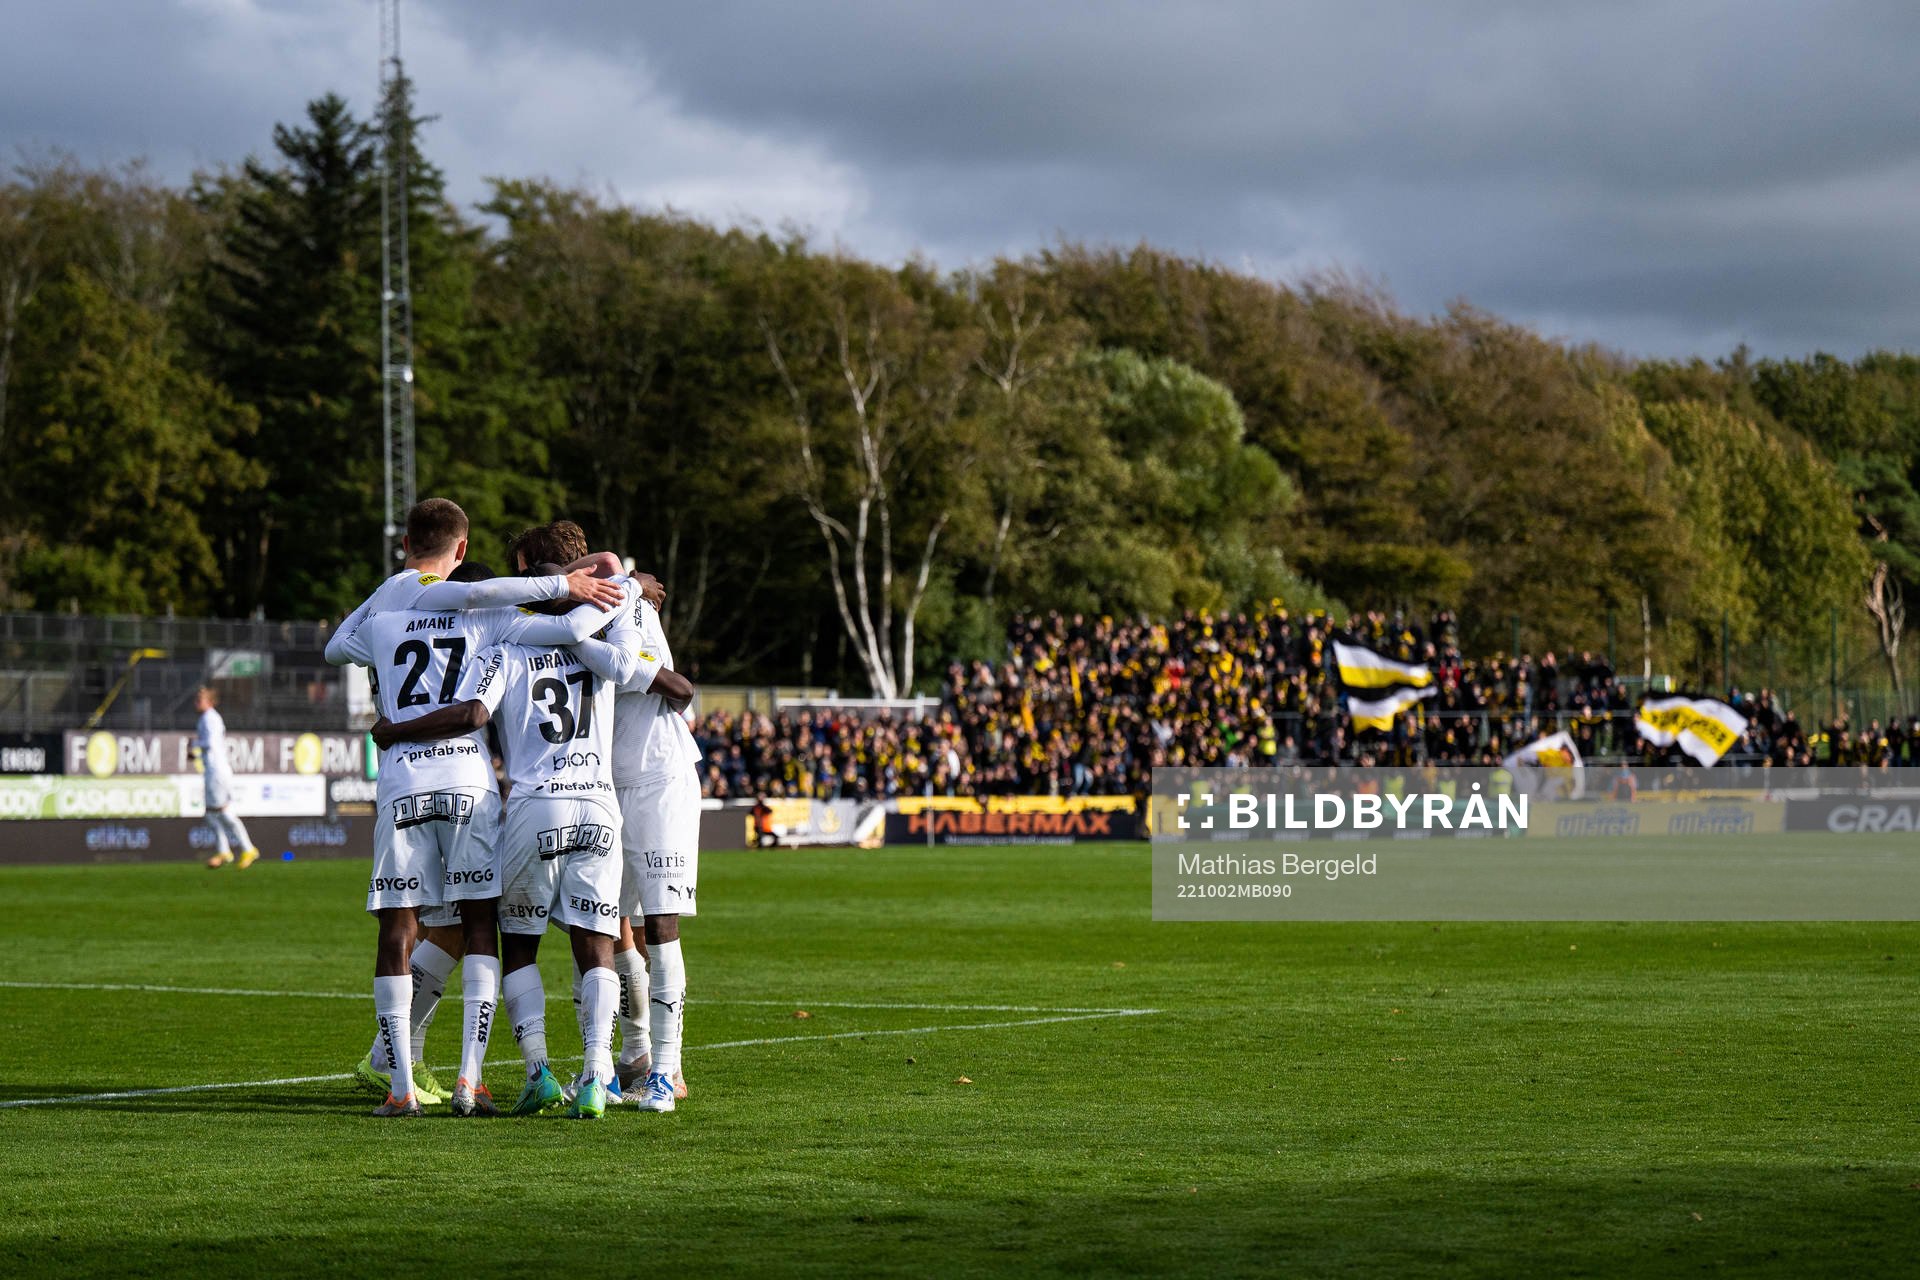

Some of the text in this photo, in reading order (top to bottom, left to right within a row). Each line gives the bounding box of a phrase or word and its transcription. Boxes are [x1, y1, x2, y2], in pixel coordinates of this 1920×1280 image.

[405, 616, 456, 633] AMANE
[393, 636, 466, 710] 27
[477, 654, 503, 695] stadium
[531, 670, 594, 745] 37
[409, 744, 479, 763] prefab syd
[551, 782, 595, 793] prefab
[393, 793, 475, 822] DEMO
[537, 824, 615, 854] DEMO
[644, 851, 685, 868] Varis
